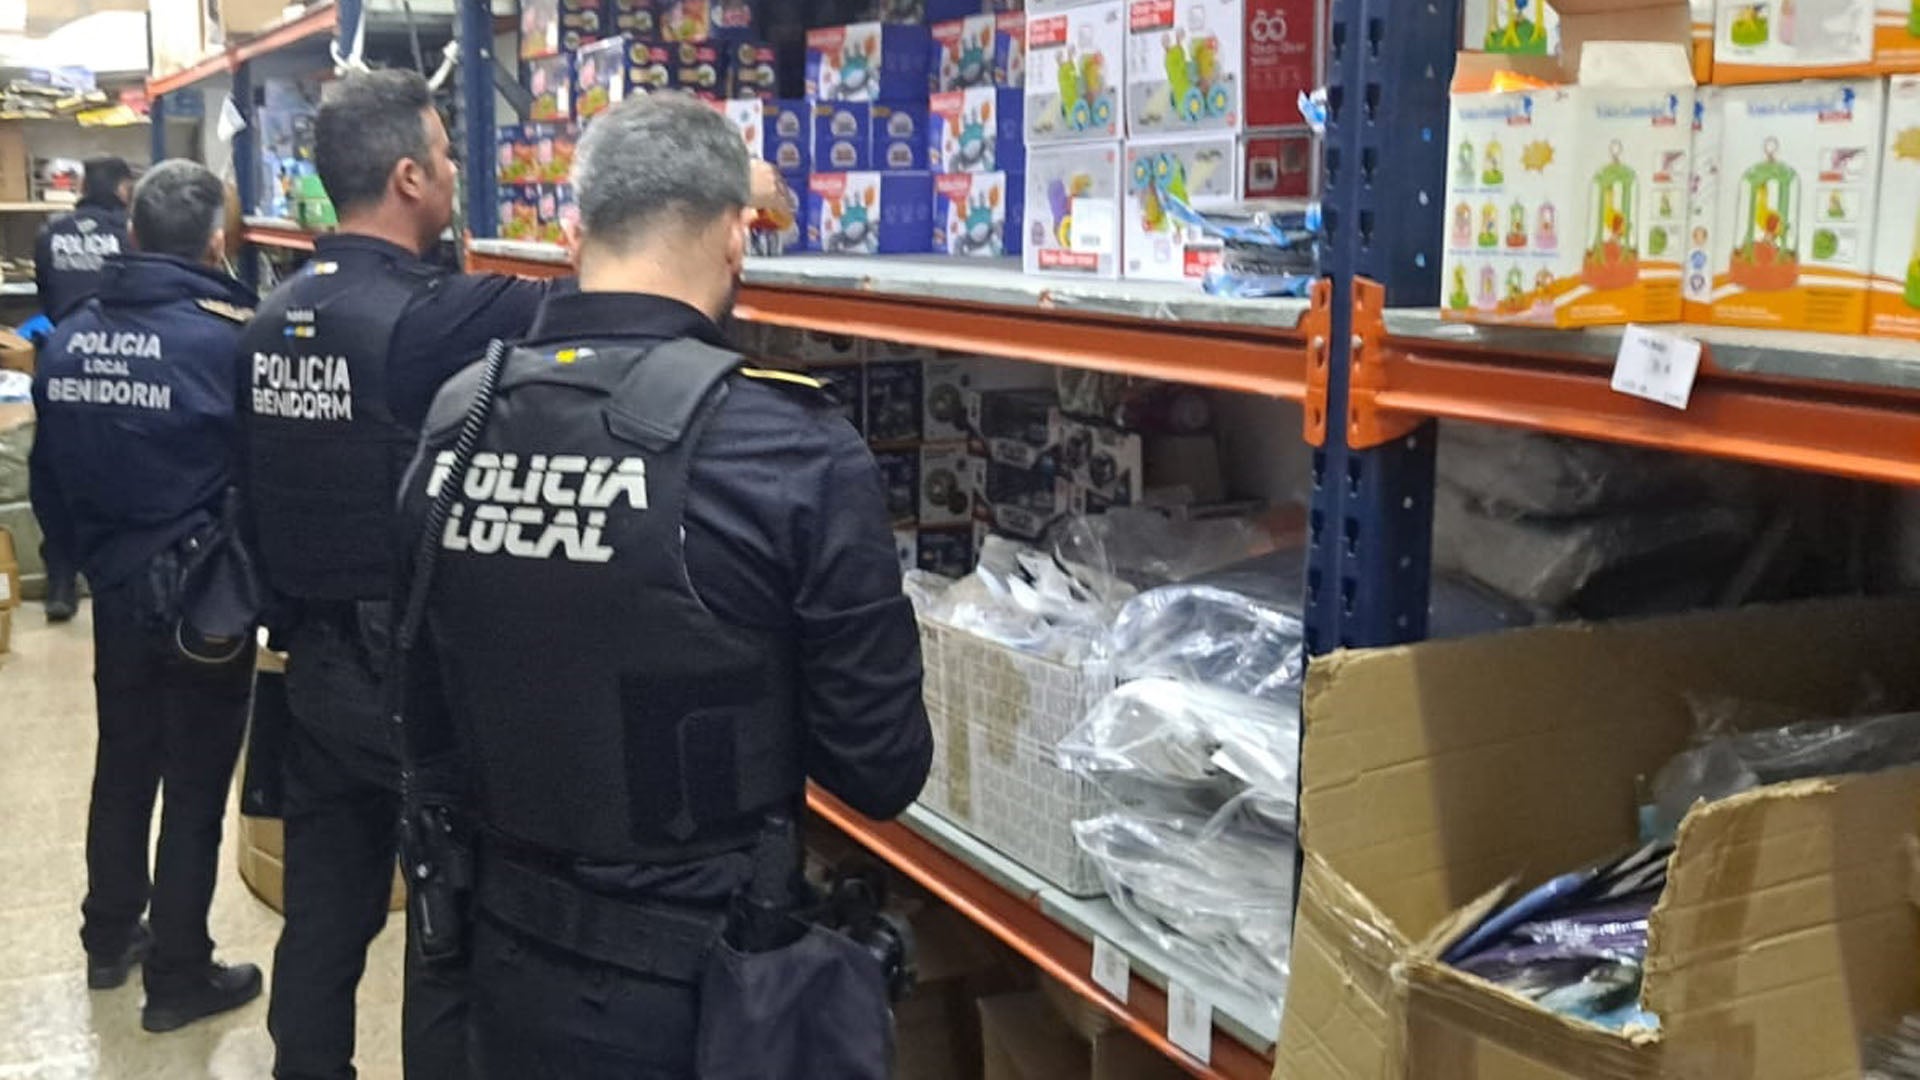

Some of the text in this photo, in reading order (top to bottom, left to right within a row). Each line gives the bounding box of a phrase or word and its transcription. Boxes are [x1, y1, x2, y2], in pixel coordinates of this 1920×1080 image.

[66, 331, 162, 360] POLICIA
[83, 357, 130, 377] LOCAL
[47, 376, 171, 411] BENIDORM
[251, 386, 353, 421] BENIDORM
[441, 502, 615, 563] LOCAL
